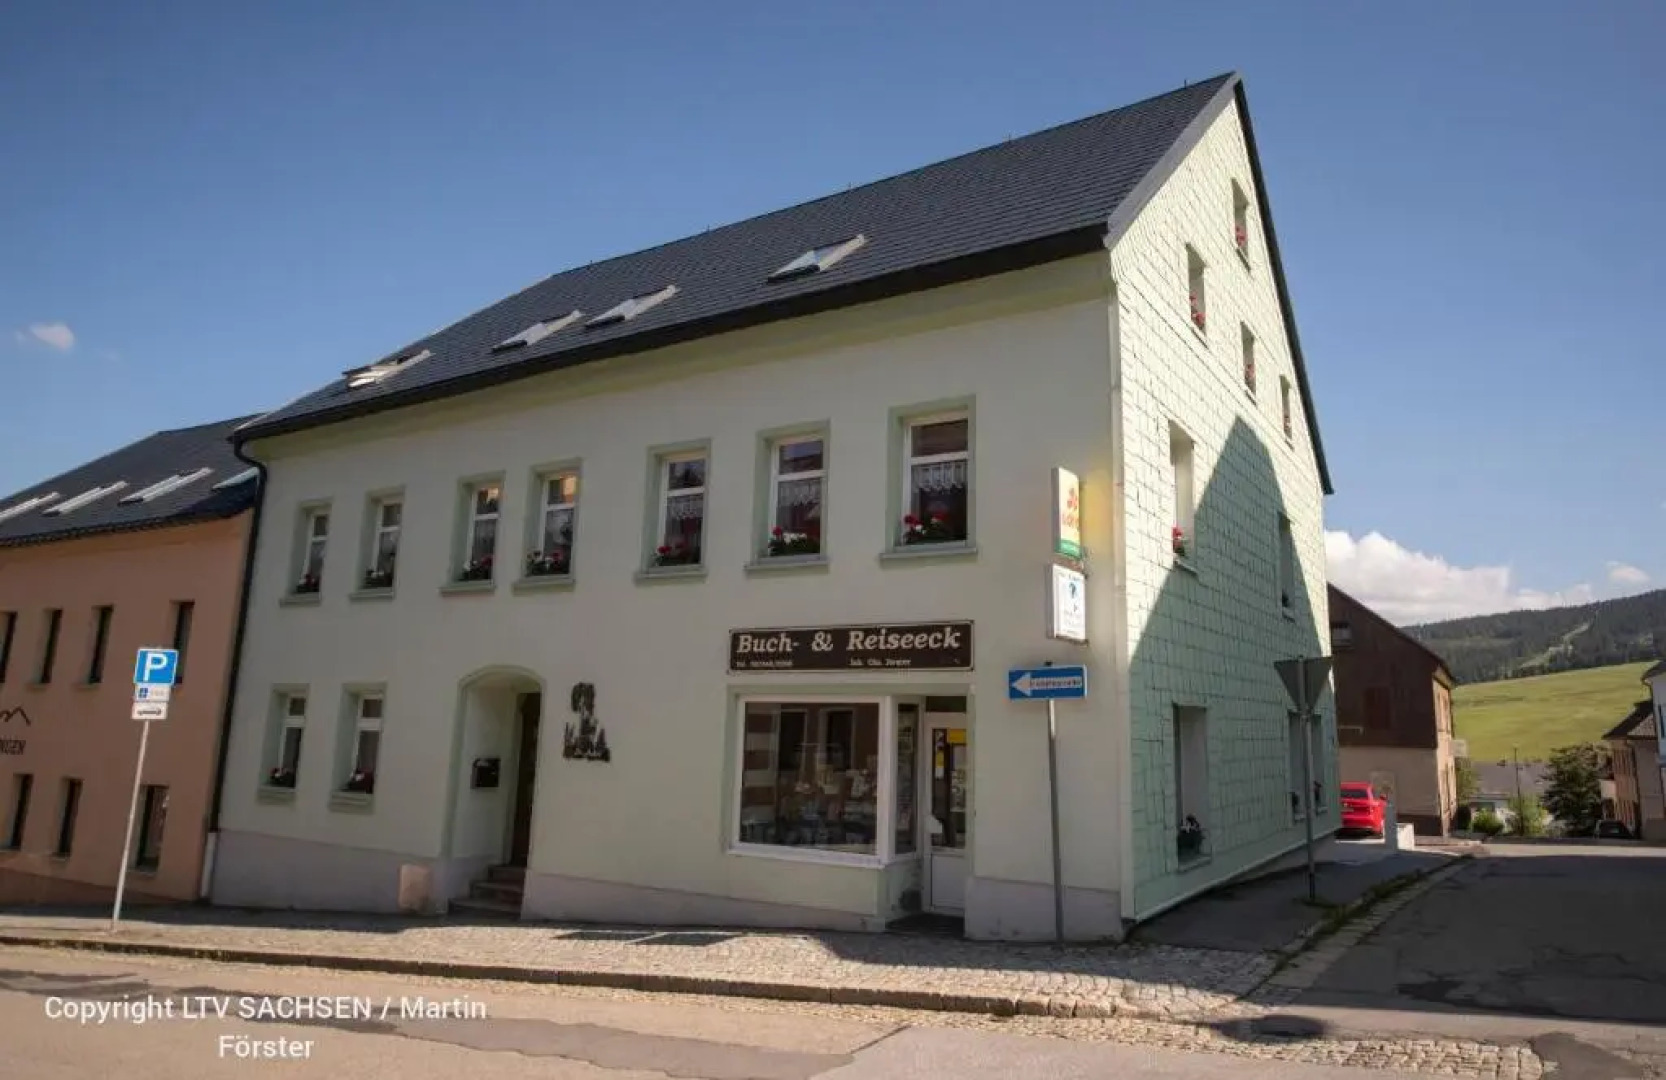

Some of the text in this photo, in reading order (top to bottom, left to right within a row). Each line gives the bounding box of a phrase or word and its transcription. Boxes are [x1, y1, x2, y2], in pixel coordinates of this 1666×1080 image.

[736, 627, 961, 653] Buch- & Reiseeck
[143, 653, 168, 681] P
